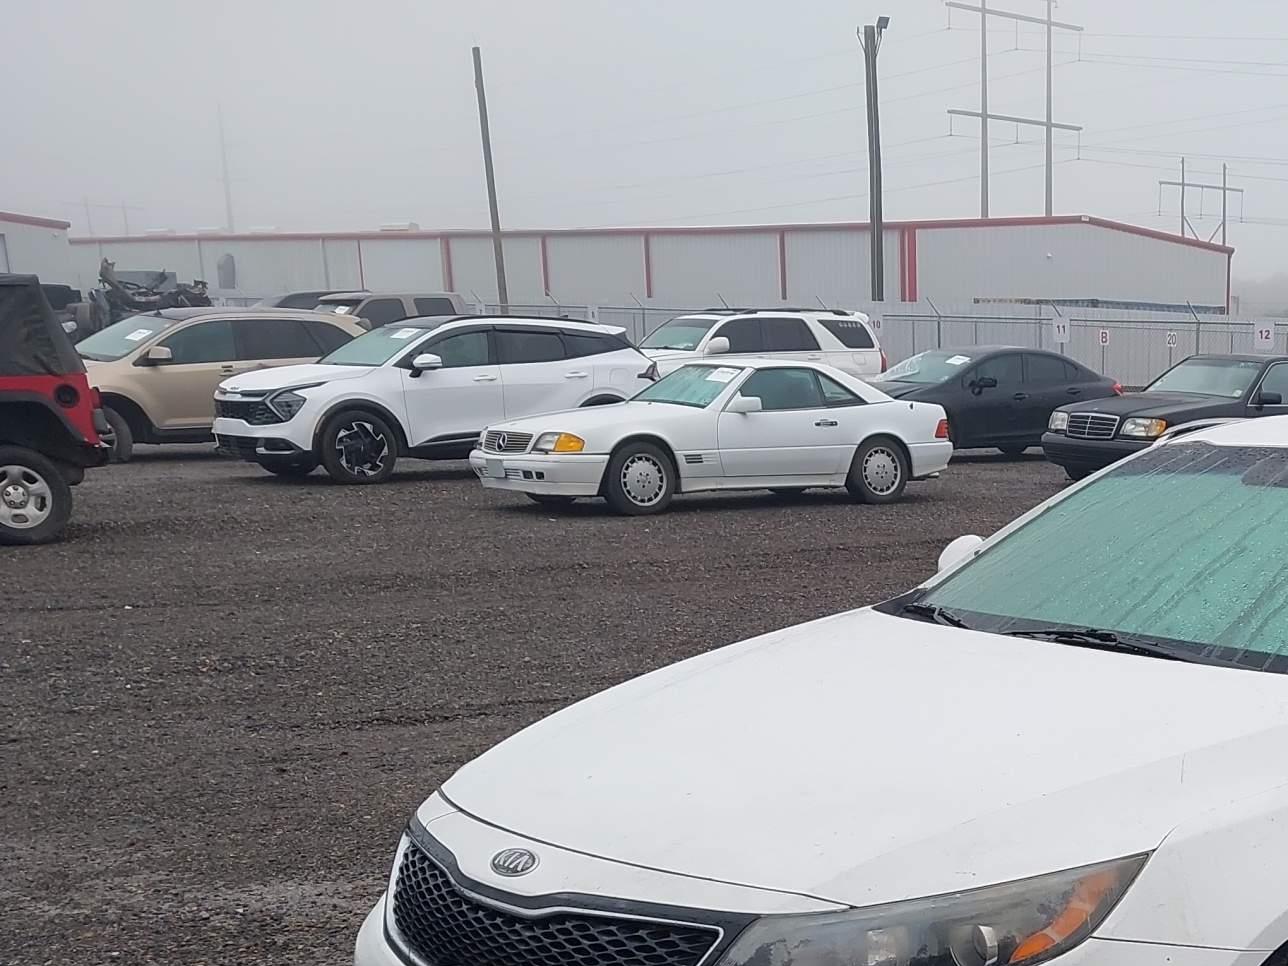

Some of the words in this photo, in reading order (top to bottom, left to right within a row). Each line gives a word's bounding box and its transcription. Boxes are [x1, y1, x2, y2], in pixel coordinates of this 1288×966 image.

[872, 319, 882, 330] 10
[1056, 324, 1067, 335] 11
[1101, 331, 1108, 344] B
[1167, 333, 1177, 346] 20
[1258, 329, 1271, 341] 12
[493, 850, 531, 873] KIA
